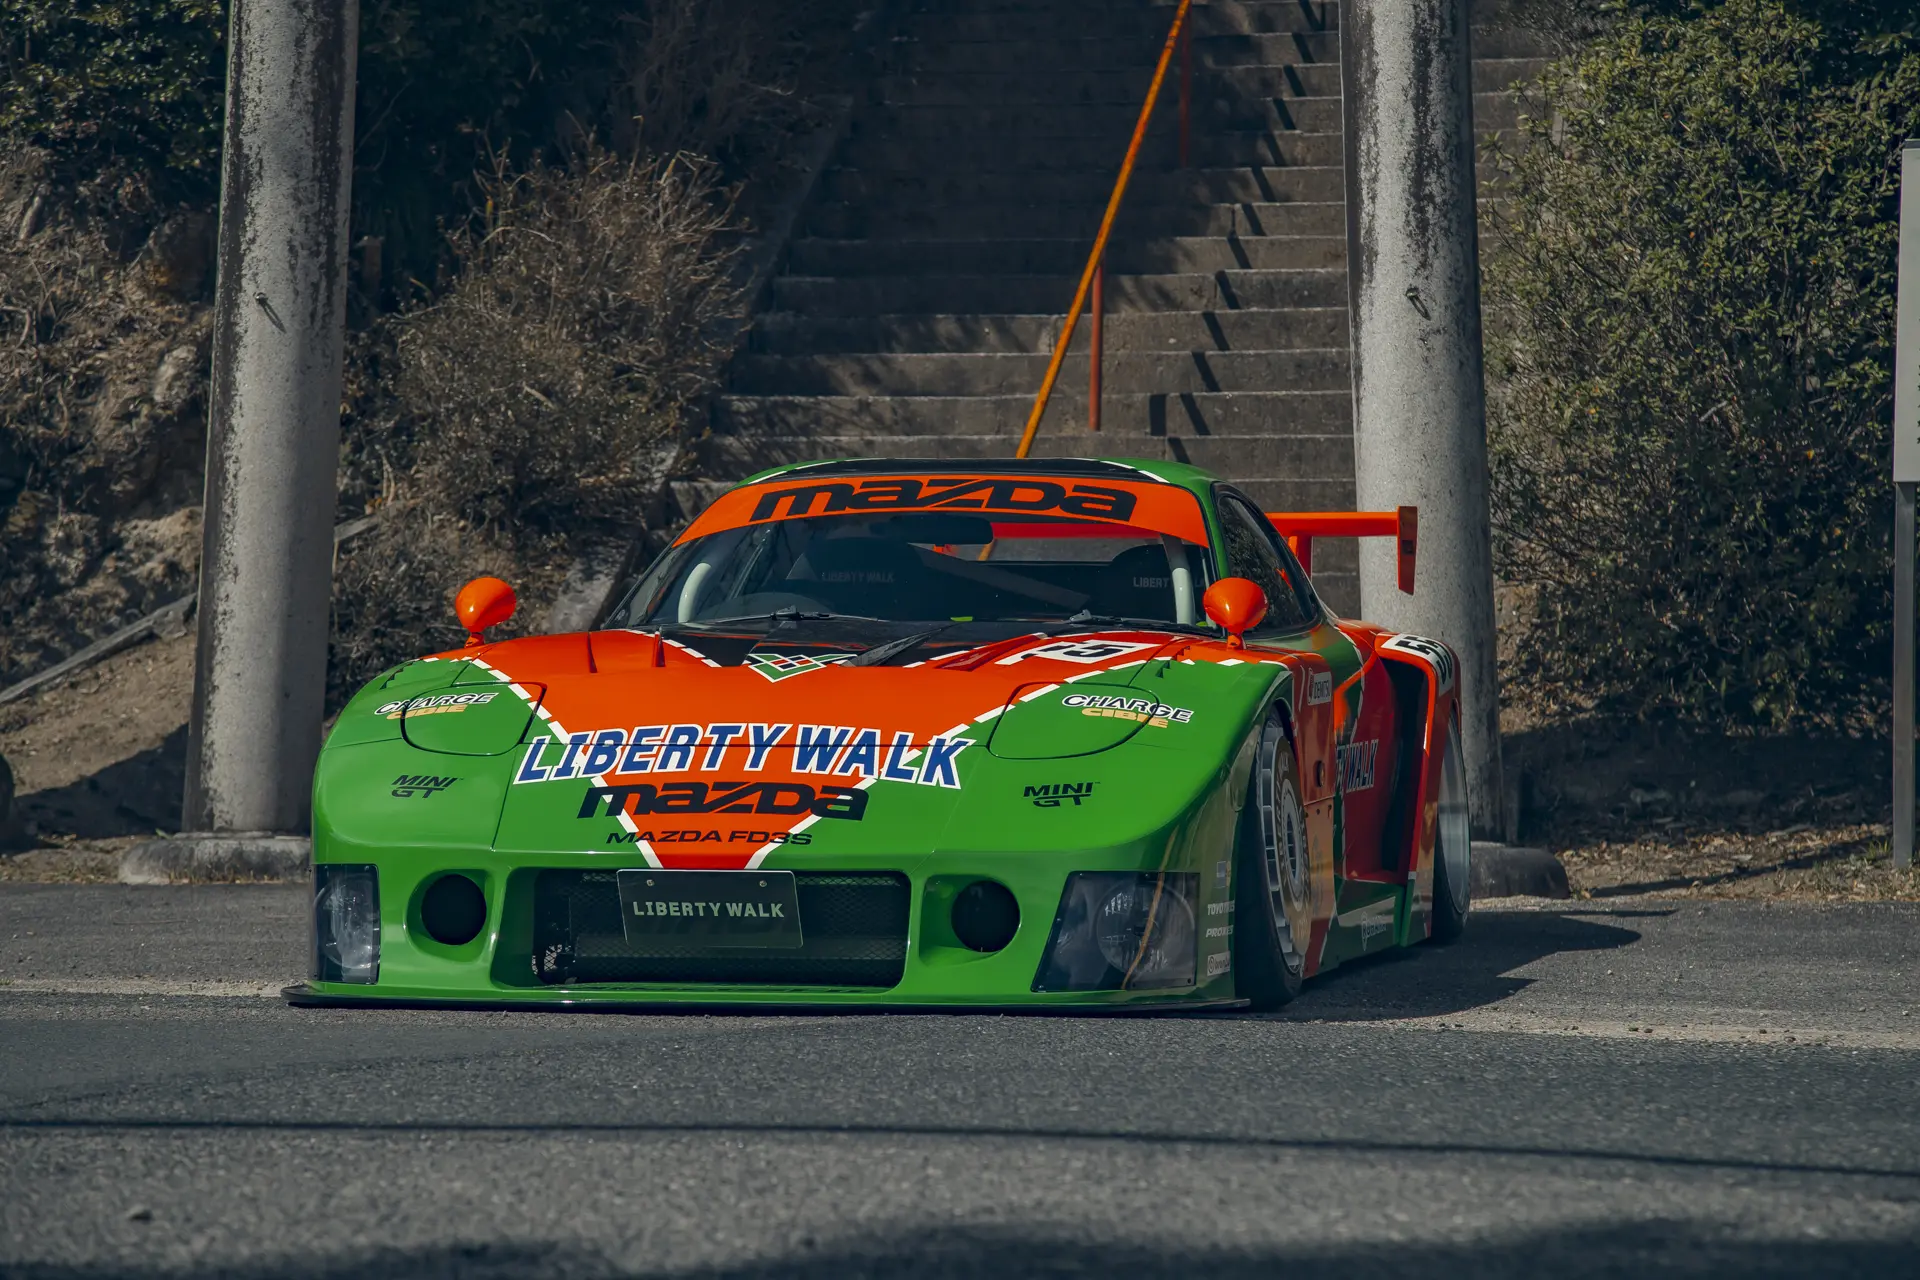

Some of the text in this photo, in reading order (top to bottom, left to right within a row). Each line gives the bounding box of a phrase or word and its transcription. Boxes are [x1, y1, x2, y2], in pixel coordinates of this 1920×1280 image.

[1133, 577, 1170, 588] LIBERT
[374, 692, 500, 715] CHARGE
[1062, 694, 1195, 723] CHARGE
[1081, 708, 1169, 728] CIBIE
[512, 723, 977, 790] LIBERTY WALK
[391, 774, 459, 788] MINI
[391, 786, 447, 799] GT
[1023, 782, 1094, 798] MINI
[1033, 794, 1091, 808] GT
[605, 830, 813, 846] MAZDA FD3S
[633, 901, 785, 918] LIBERTY WALK
